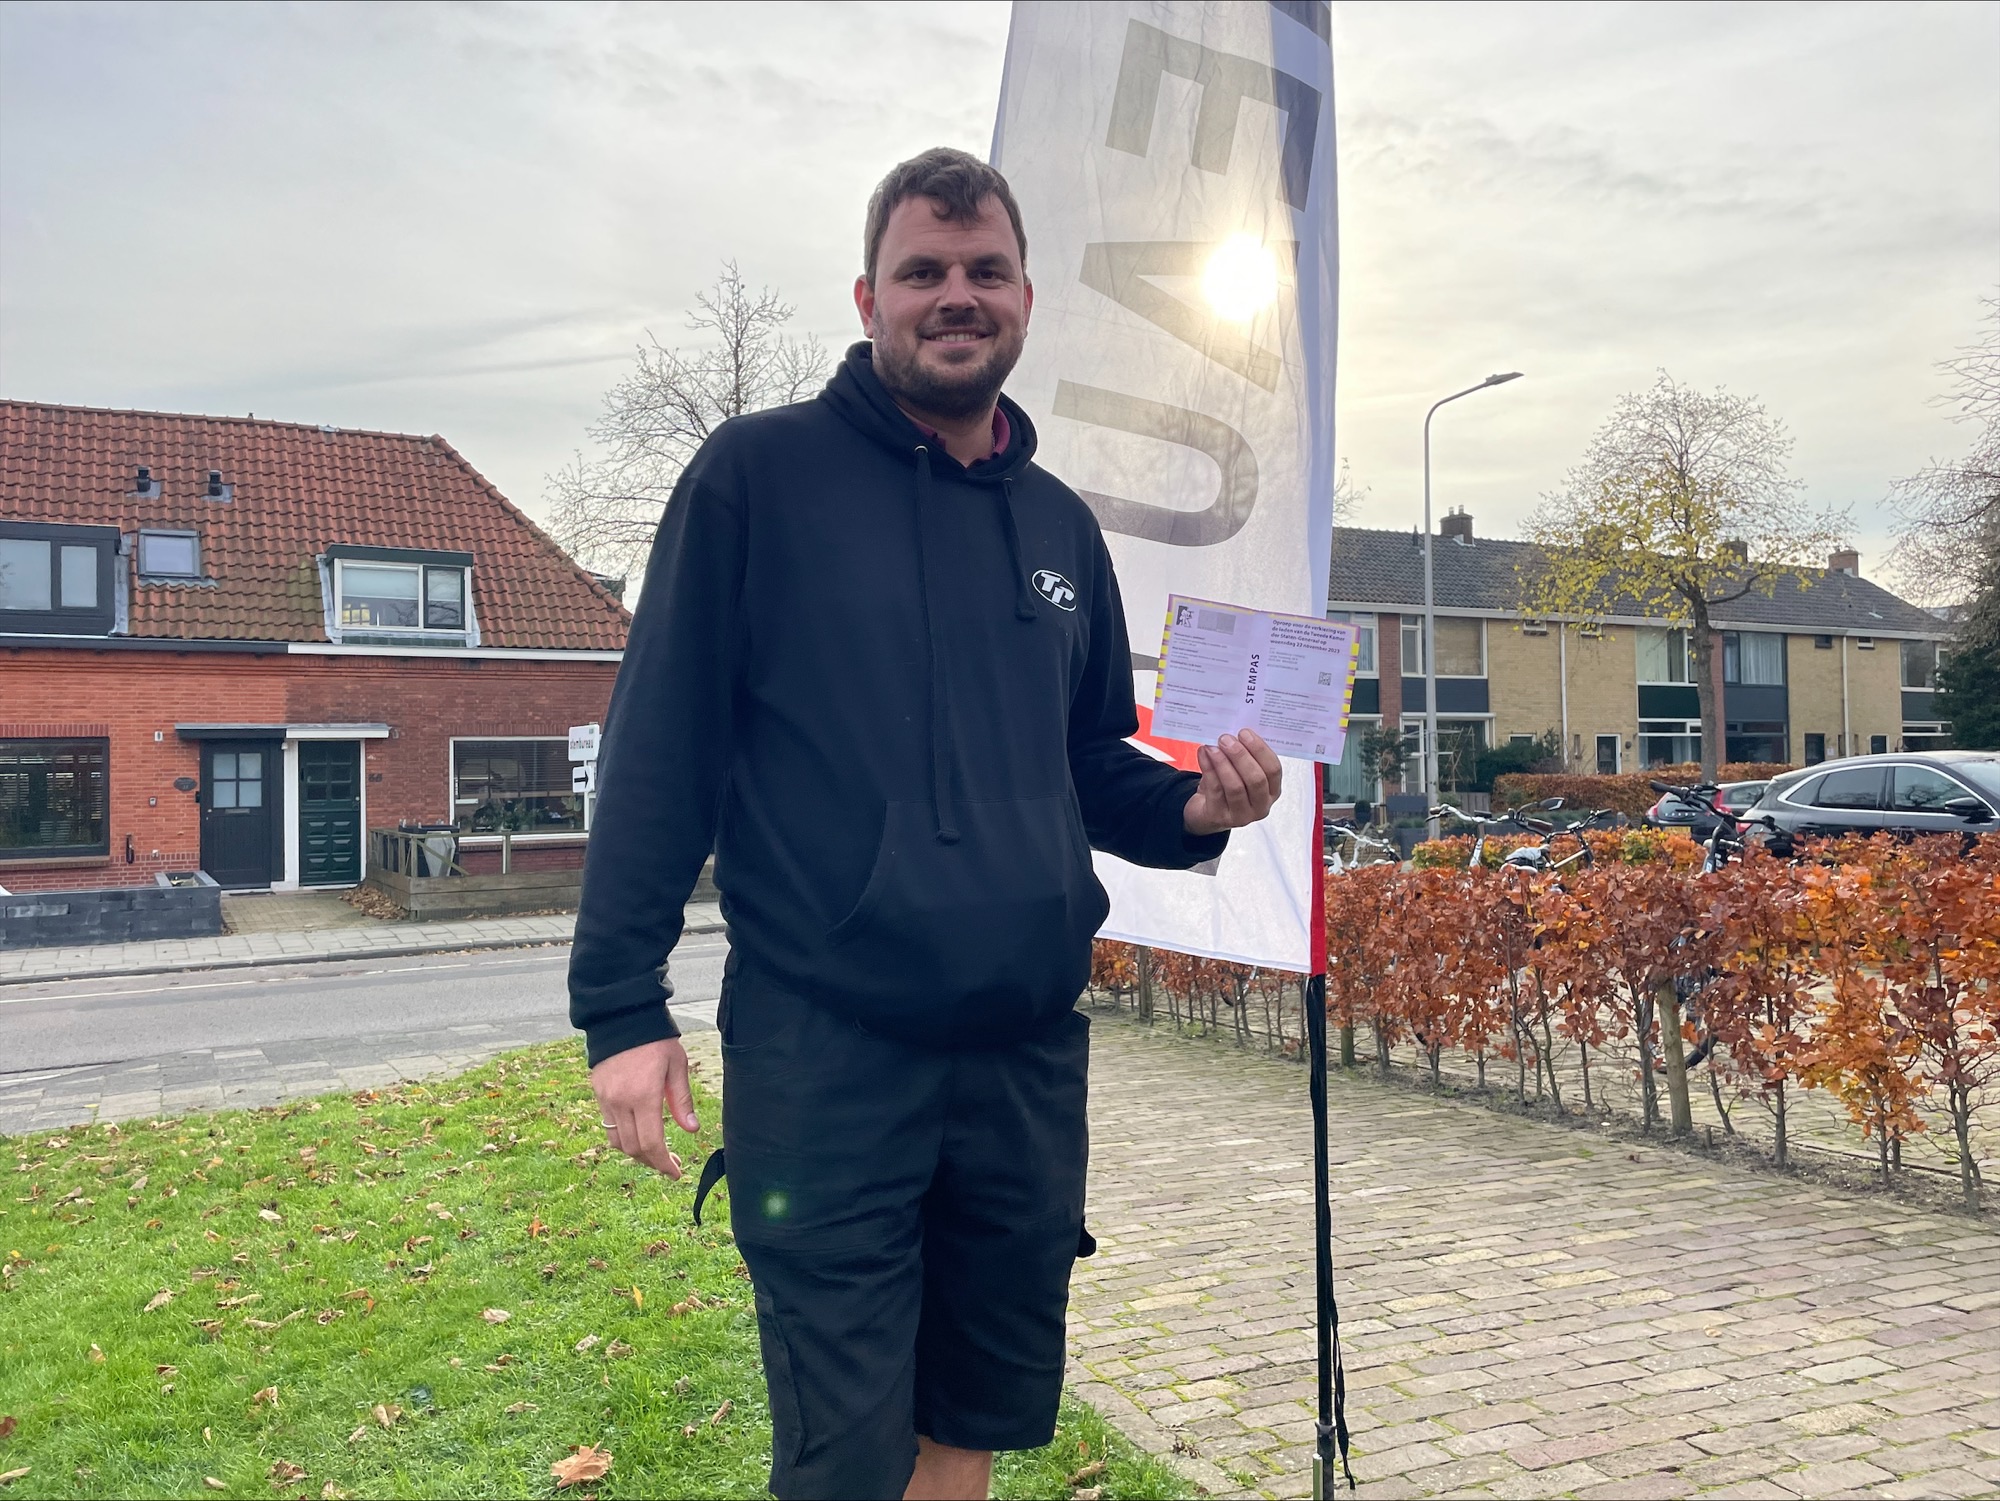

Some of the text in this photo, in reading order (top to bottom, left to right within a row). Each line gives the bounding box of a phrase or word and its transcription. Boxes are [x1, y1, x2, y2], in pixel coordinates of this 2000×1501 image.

[1312, 625, 1336, 634] verkiezing
[1280, 634, 1319, 643] Staten-Generaal
[1270, 639, 1296, 647] woensdag
[1303, 643, 1327, 651] november
[1245, 654, 1260, 704] STEMPAS
